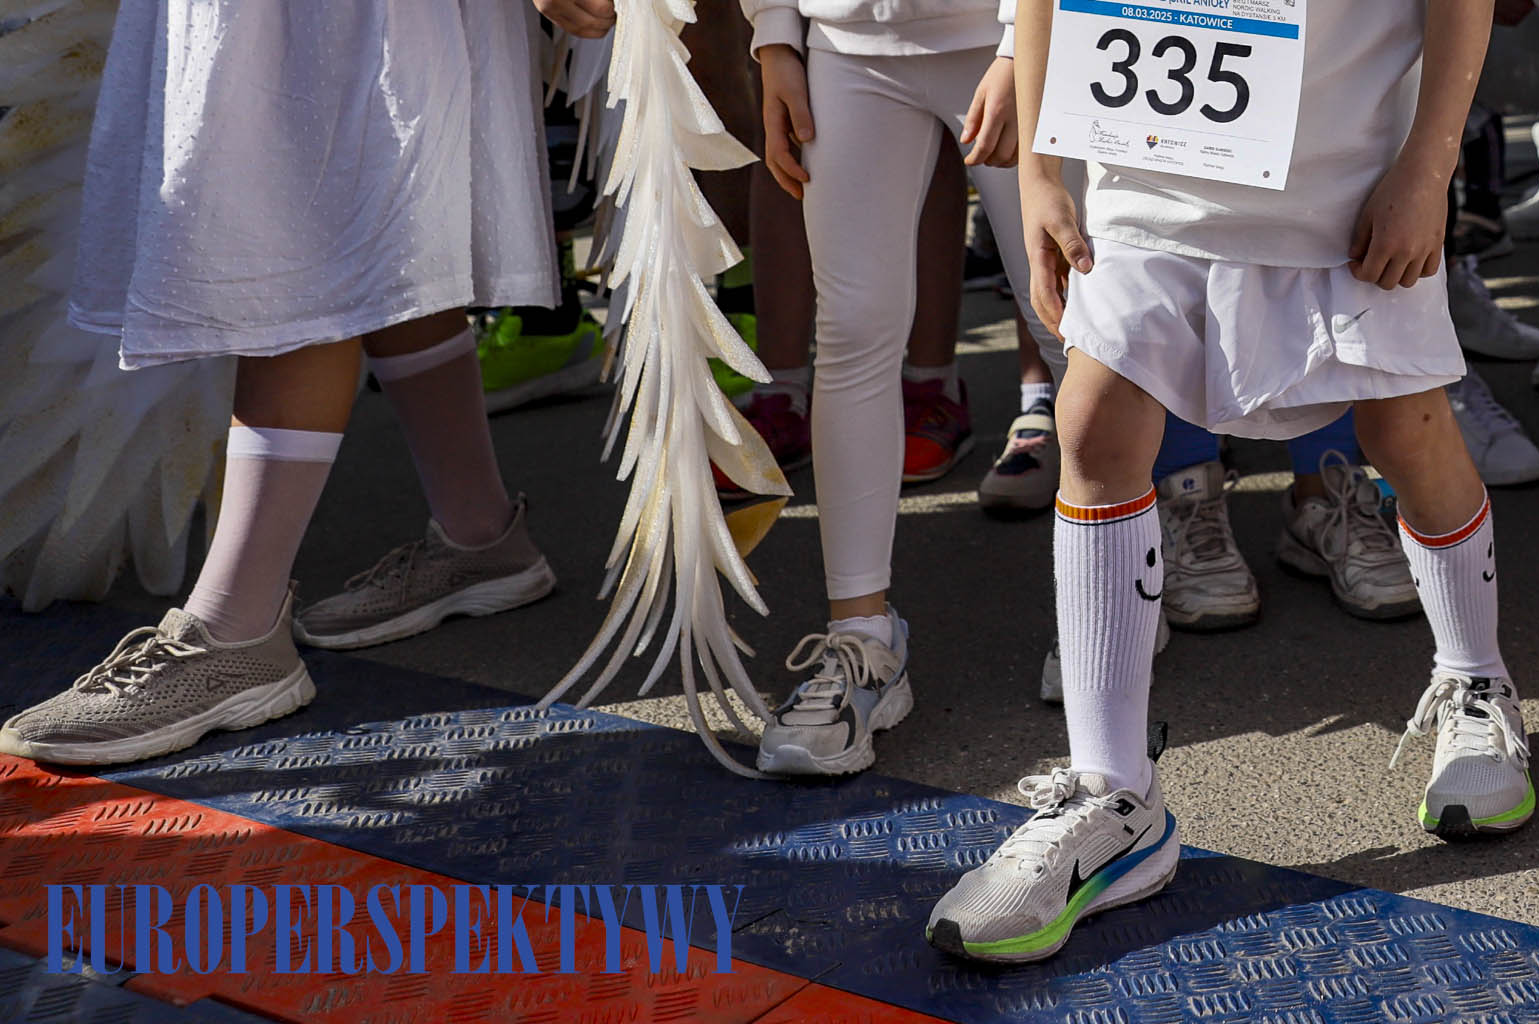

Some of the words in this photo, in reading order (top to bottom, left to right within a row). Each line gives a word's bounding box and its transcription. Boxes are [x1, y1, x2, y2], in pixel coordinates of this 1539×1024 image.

[1121, 6, 1173, 21] 08.03.2025
[1179, 13, 1233, 29] KATOWICE
[1090, 28, 1253, 123] 335
